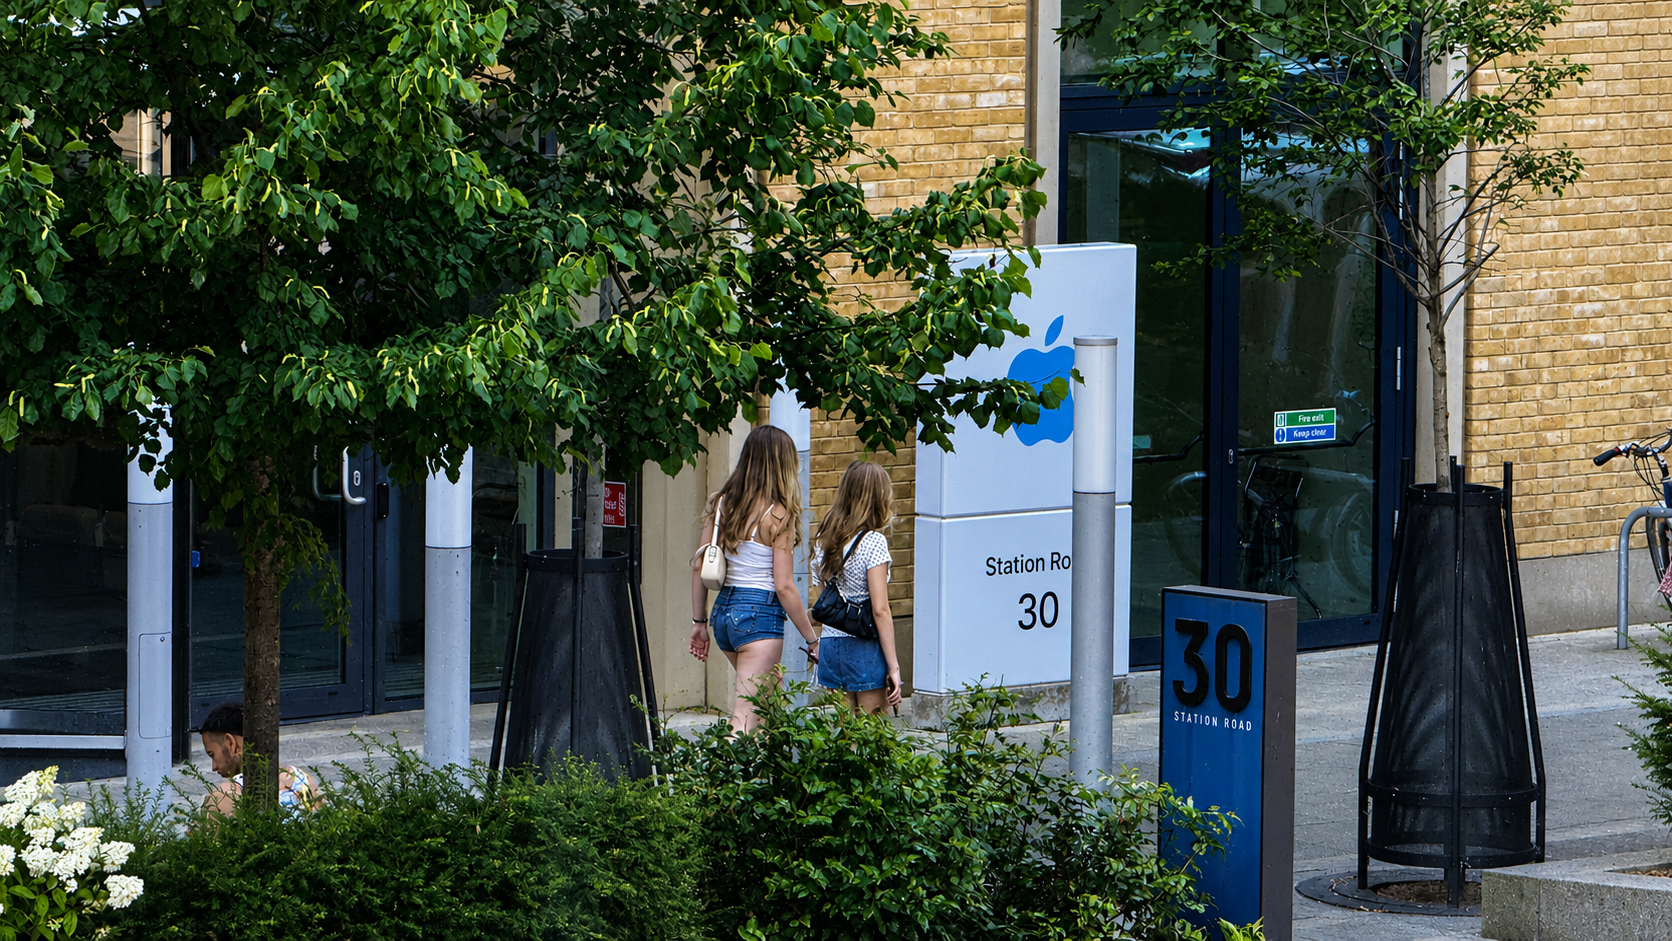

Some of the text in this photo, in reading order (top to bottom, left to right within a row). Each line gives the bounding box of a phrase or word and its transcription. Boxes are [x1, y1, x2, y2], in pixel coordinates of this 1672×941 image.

[985, 551, 1072, 577] Station Ro
[1018, 591, 1059, 630] 30
[1172, 618, 1252, 713] 30
[1173, 710, 1252, 731] STATION ROAD
